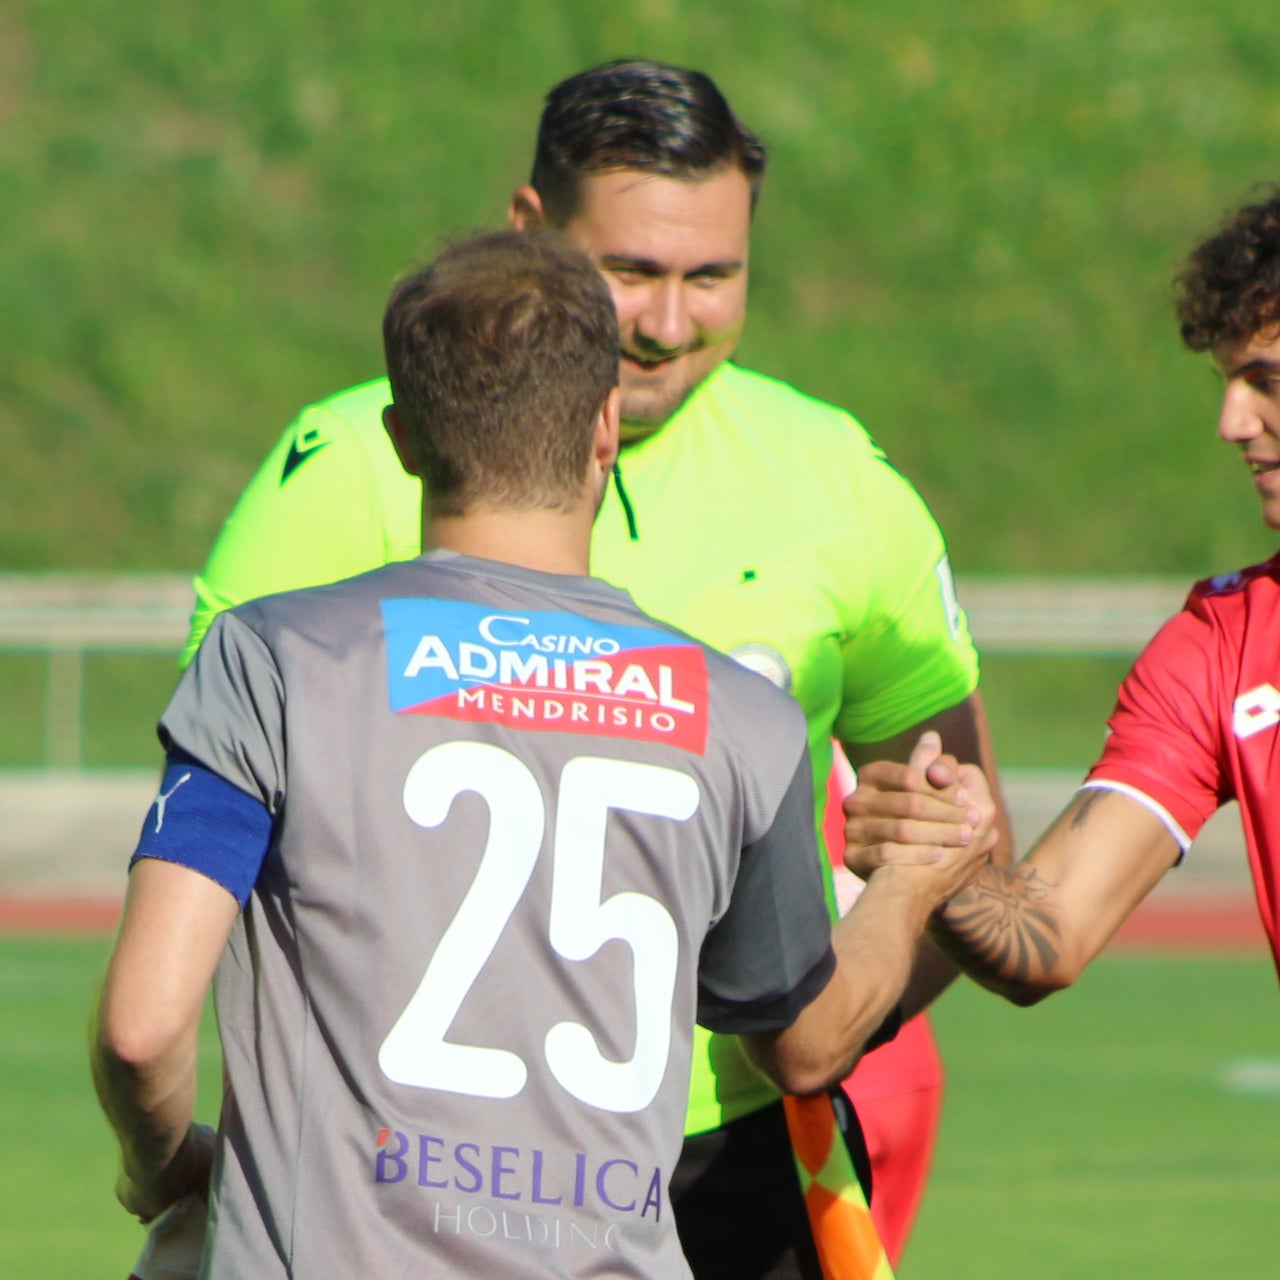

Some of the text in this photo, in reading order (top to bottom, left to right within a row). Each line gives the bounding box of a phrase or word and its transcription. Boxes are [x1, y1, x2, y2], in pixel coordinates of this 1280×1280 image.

[403, 634, 695, 715] ADMIRAL
[456, 687, 676, 733] MENDRISIO
[378, 741, 701, 1113] 25
[375, 1128, 662, 1223] BESELICA
